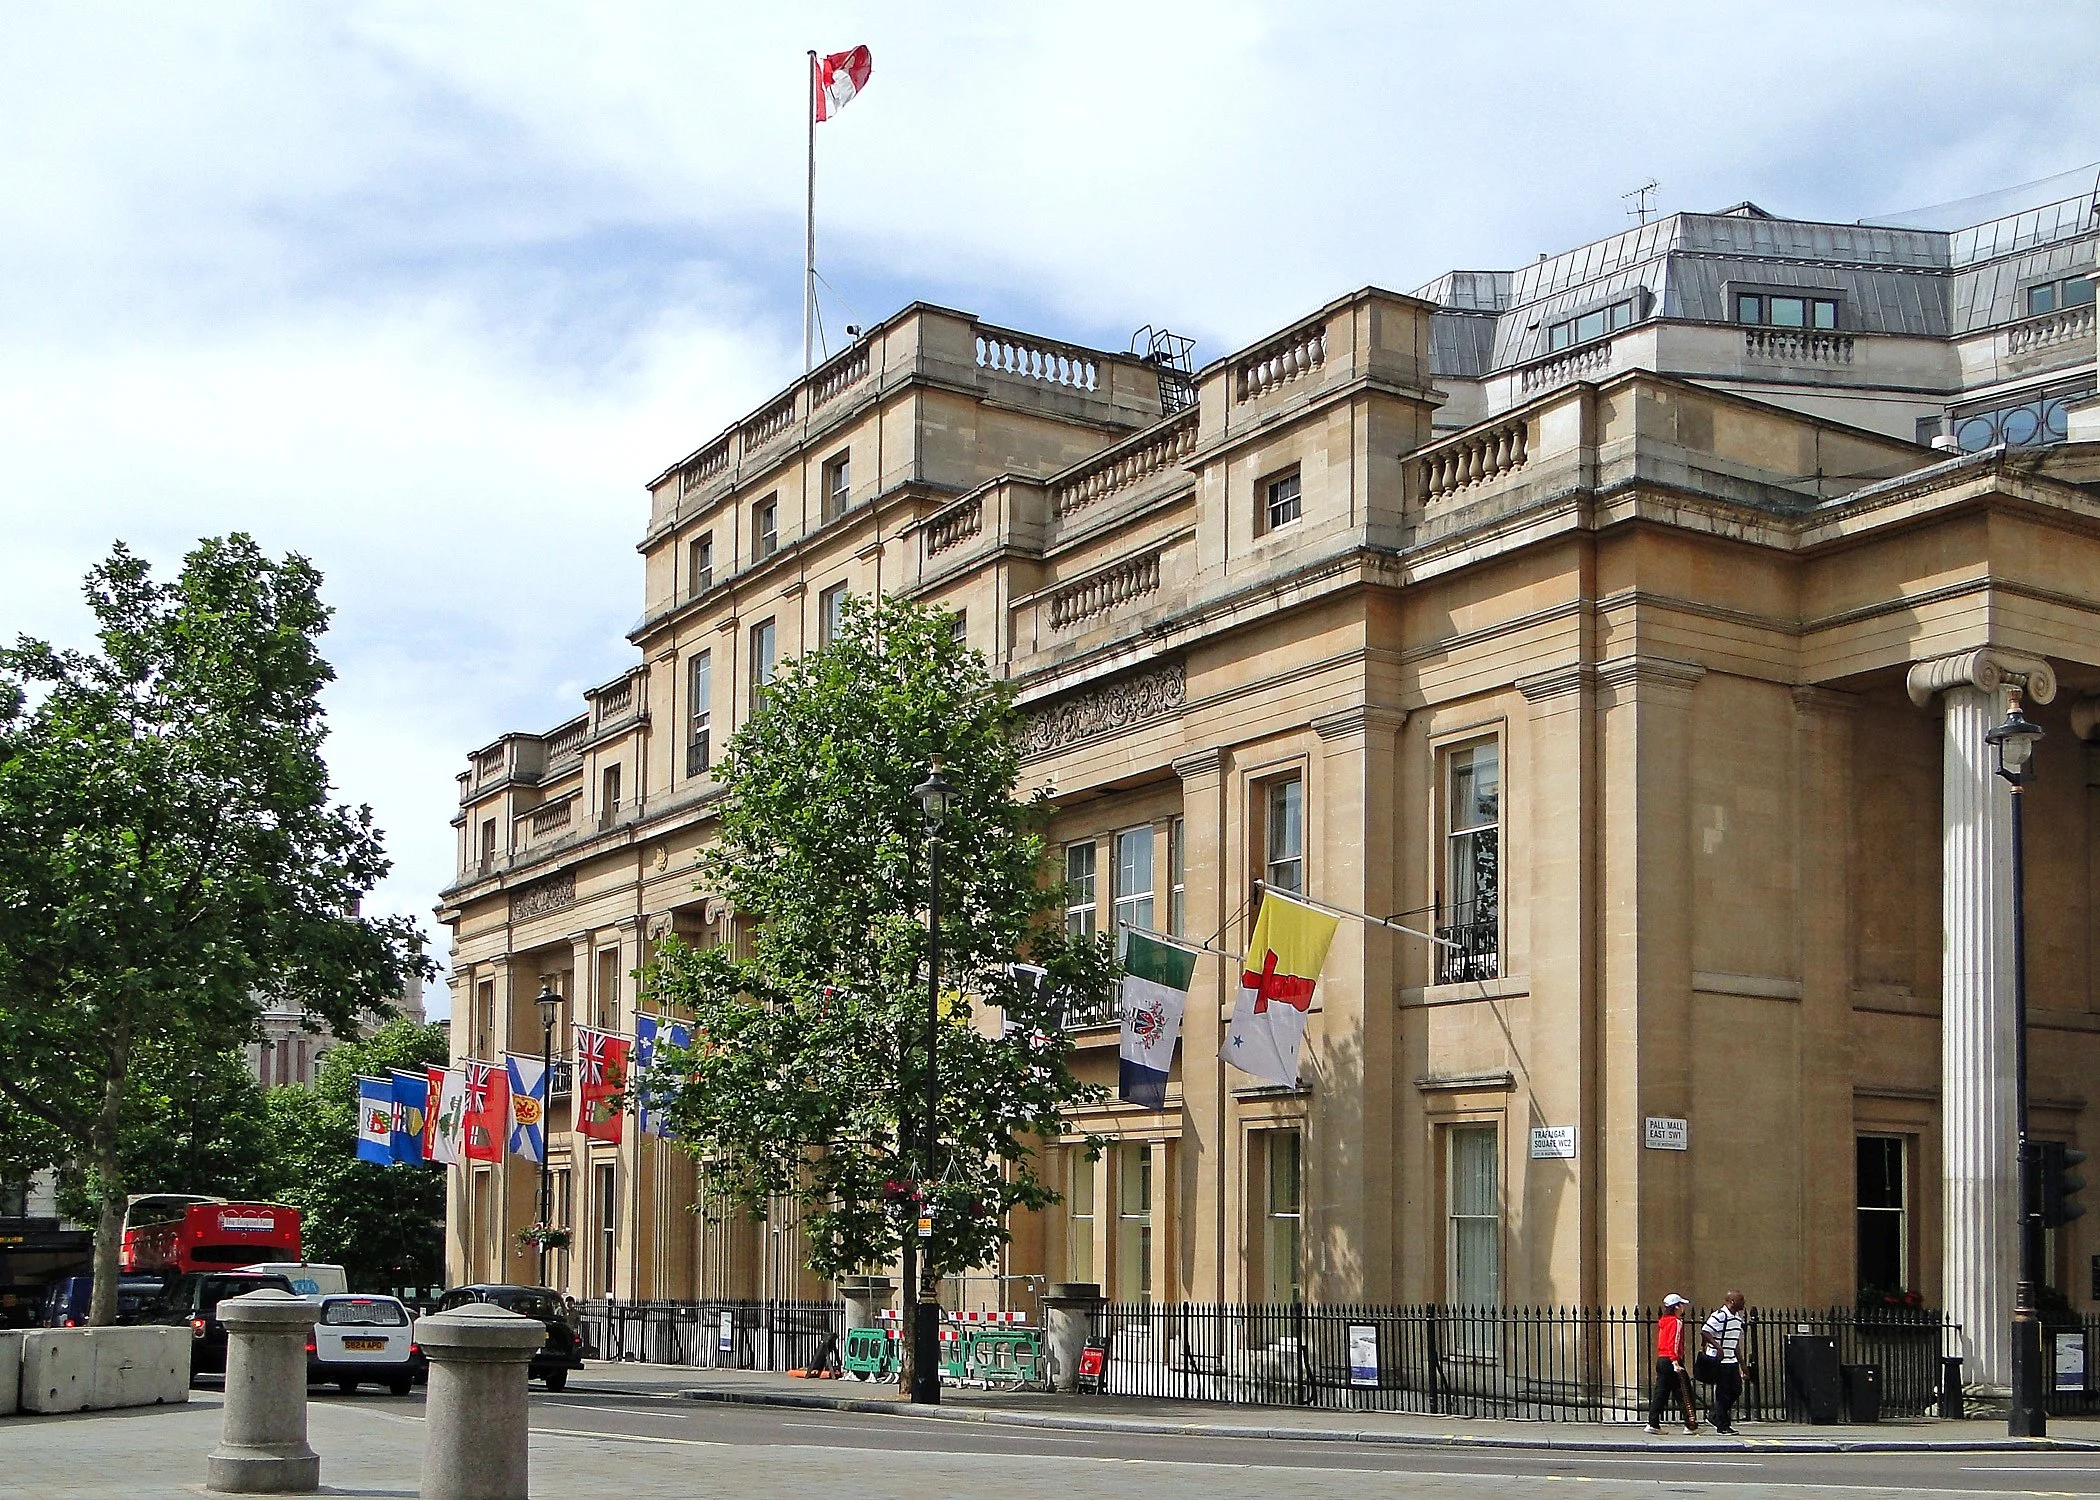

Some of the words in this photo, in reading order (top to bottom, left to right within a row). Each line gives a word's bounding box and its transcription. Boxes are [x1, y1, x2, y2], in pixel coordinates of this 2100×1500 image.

[1650, 1120, 1664, 1129] PALL
[1667, 1121, 1683, 1130] MALL
[1534, 1129, 1565, 1139] TRAFALGAR
[1650, 1130, 1665, 1138] EAST
[1668, 1131, 1680, 1139] SW1
[1534, 1139, 1556, 1148] SQUARE
[1558, 1139, 1571, 1147] WC2
